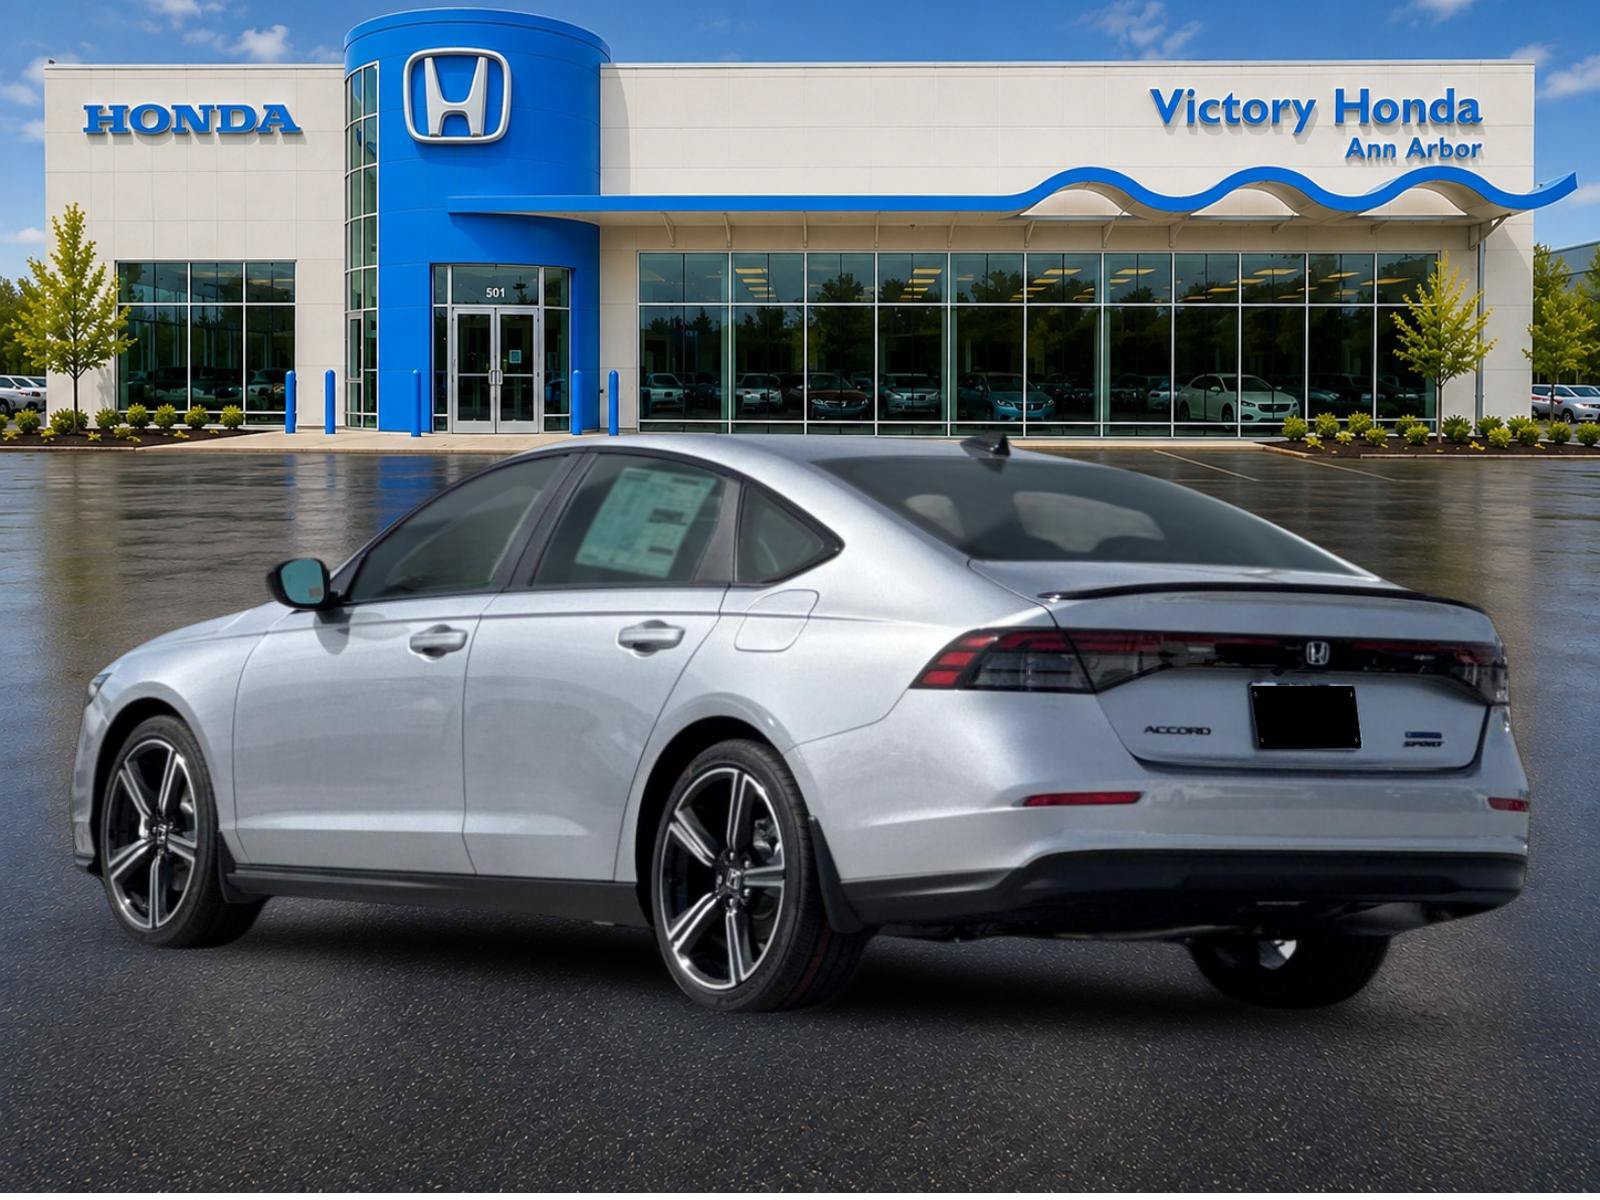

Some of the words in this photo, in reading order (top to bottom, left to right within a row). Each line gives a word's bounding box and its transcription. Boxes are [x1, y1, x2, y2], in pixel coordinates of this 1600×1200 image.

[83, 103, 302, 135] HONDA
[1150, 88, 1317, 135] Victory
[1335, 87, 1483, 125] Honda
[1345, 137, 1396, 159] Ann
[1405, 137, 1482, 159] Arbor
[485, 287, 505, 298] 501
[1143, 725, 1212, 736] ACCORD
